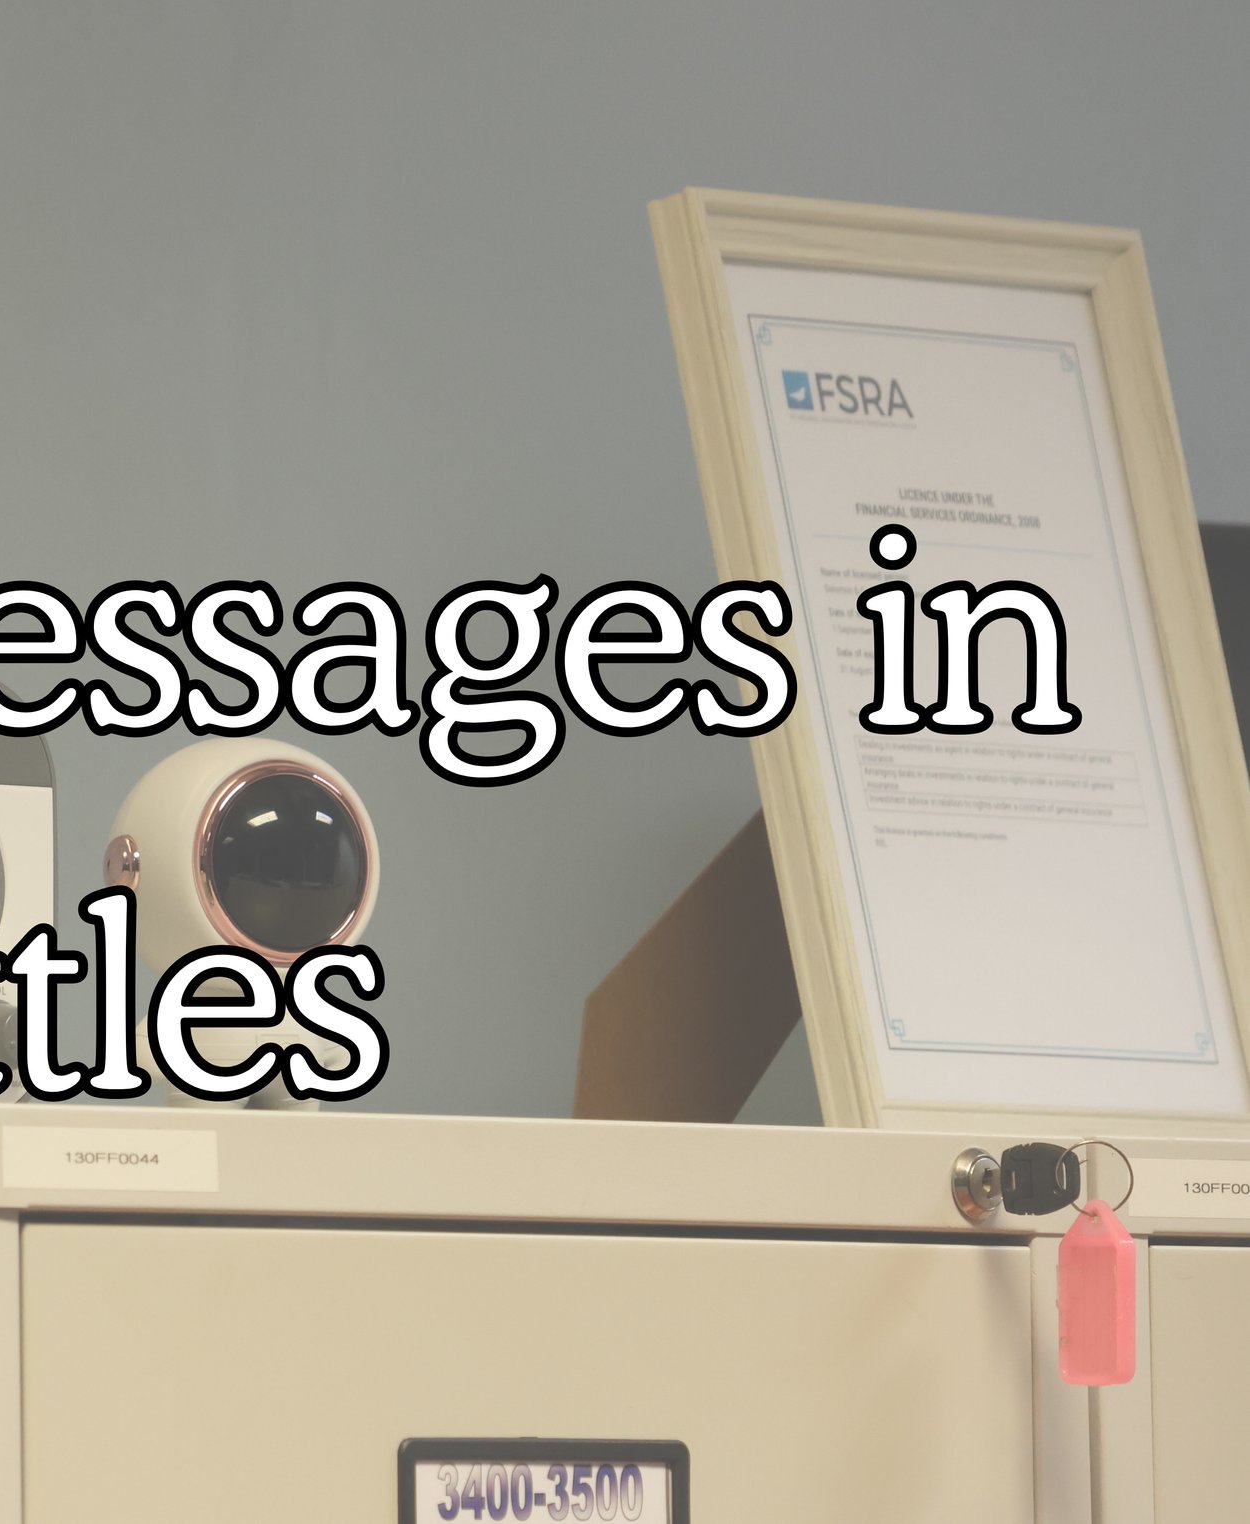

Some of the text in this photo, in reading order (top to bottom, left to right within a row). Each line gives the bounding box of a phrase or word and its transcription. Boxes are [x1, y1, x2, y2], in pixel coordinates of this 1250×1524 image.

[815, 372, 914, 418] FSRA
[898, 487, 995, 507] LICENCE UNDER THE
[855, 502, 908, 517] FINANCIAL
[910, 507, 957, 521] SERVICES
[65, 1151, 160, 1165] 130FF0044
[1184, 1182, 1250, 1195] 130FF00
[437, 1462, 644, 1521] 3400-3500
